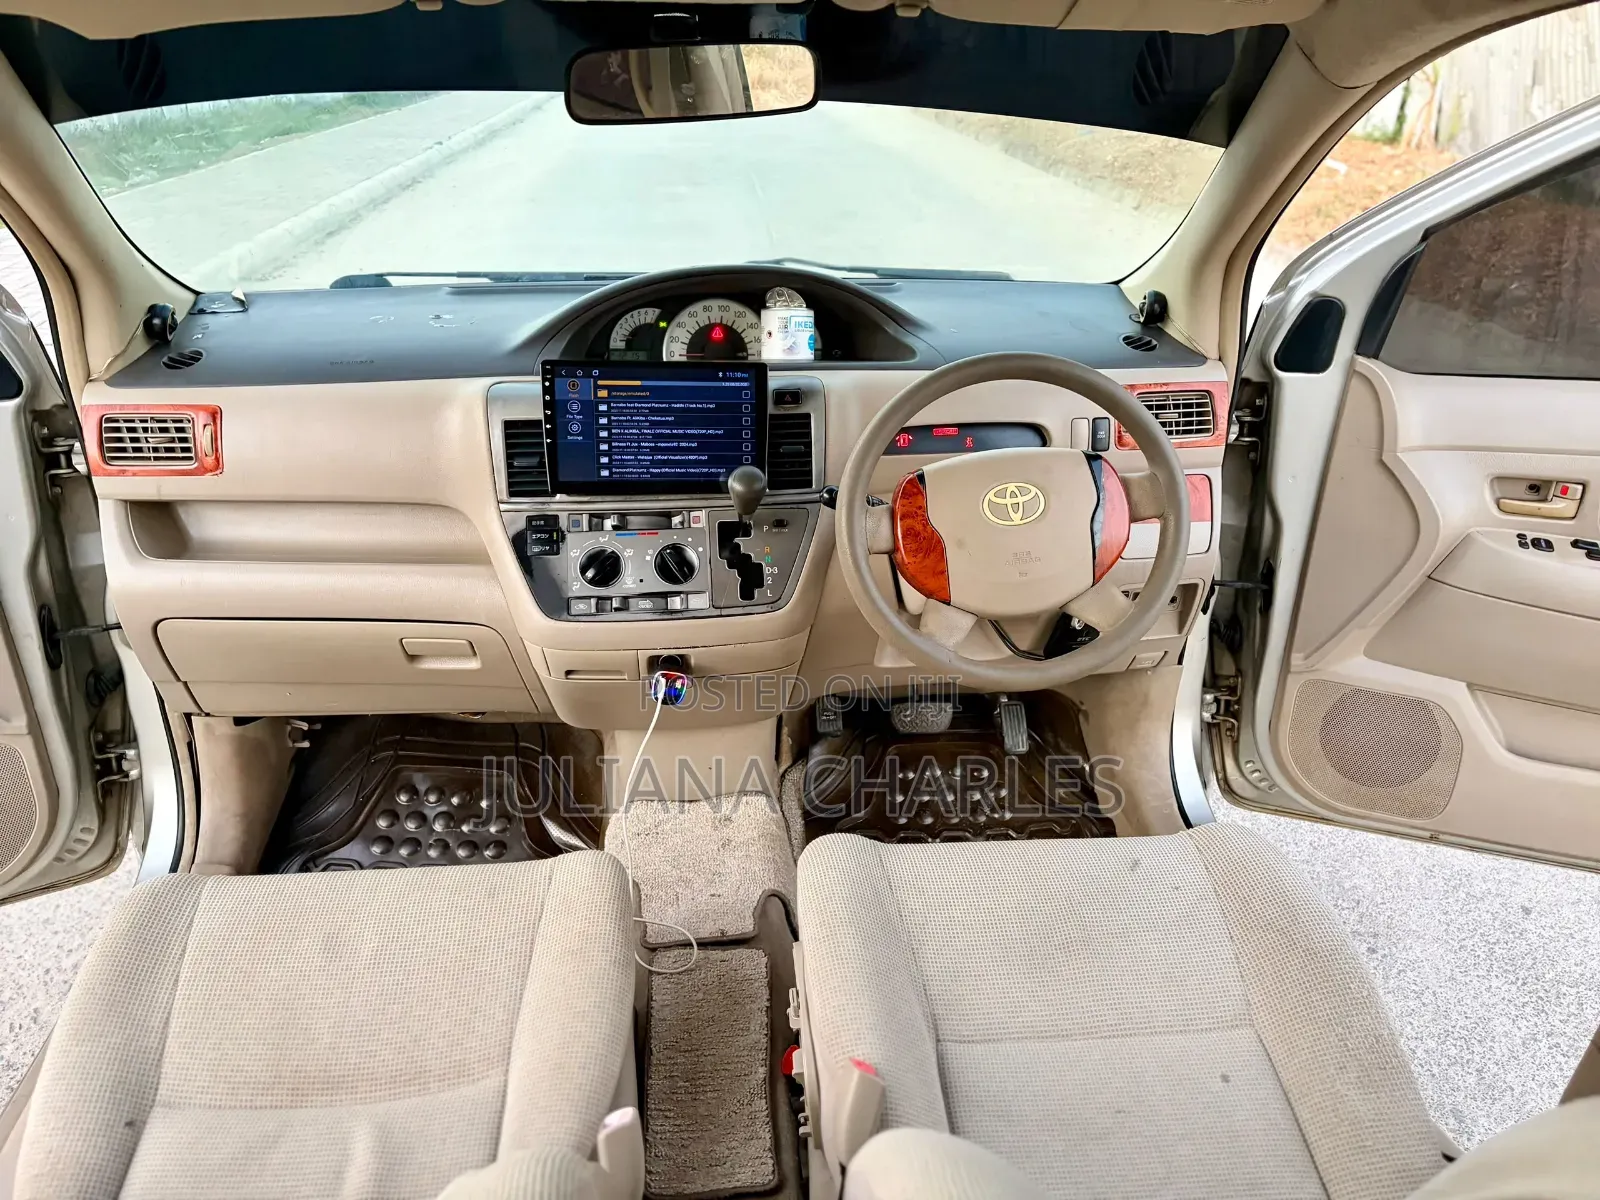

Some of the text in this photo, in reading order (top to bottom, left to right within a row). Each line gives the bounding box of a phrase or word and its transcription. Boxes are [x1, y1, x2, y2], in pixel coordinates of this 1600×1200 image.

[702, 305, 712, 313] 80
[718, 304, 730, 312] 100
[687, 310, 698, 318] 60
[734, 310, 746, 318] 120
[746, 322, 758, 330] 140
[669, 336, 680, 344] 20
[1004, 556, 1041, 565] AIRBAG
